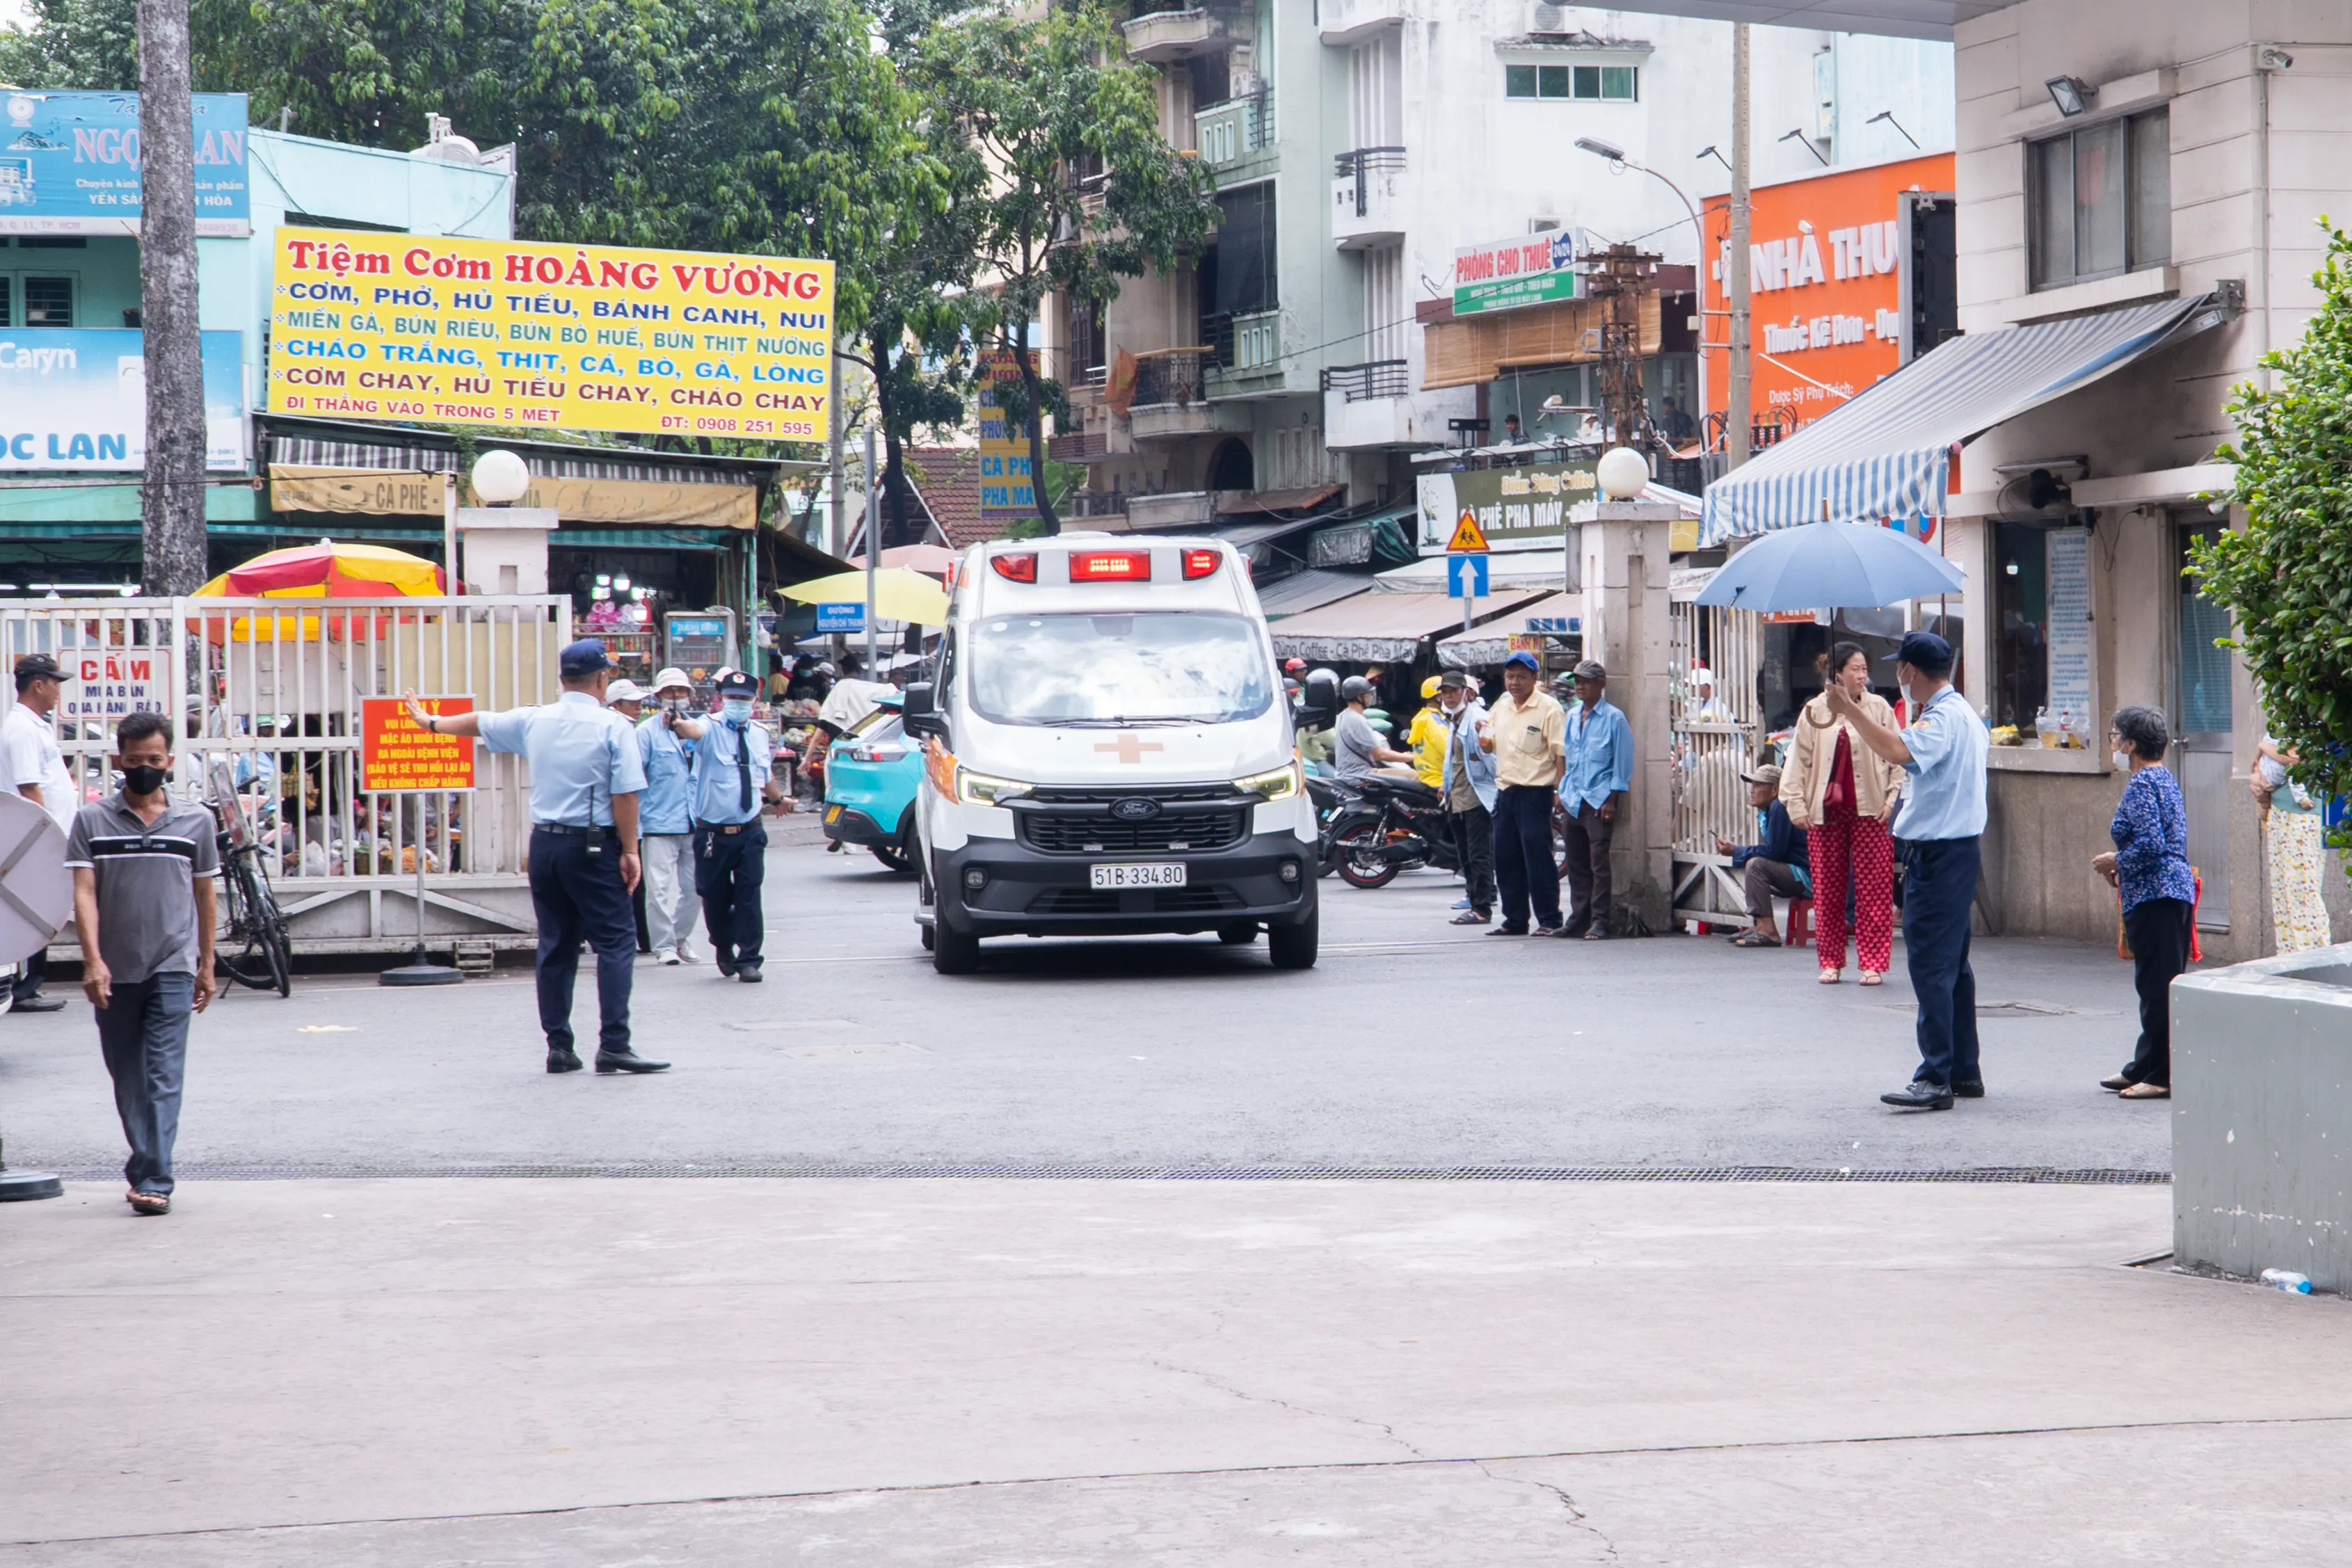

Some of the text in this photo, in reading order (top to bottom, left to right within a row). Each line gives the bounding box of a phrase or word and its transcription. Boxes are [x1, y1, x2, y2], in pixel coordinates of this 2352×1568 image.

[109, 98, 139, 118] Tạ
[74, 128, 244, 171] NGỌ AN
[288, 241, 822, 299] Tiệm Cơm HOÀNG VƯƠNG
[1457, 237, 1570, 282] PHÒNG CHO THUÊ 24/24
[1750, 221, 1898, 294] NHÀ THU
[289, 282, 825, 329] CƠM, PHỞ, HỦ TIẾU, BÁNH CANH, NUI
[351, 311, 385, 335] GÀ,
[394, 313, 437, 335] BÚN
[447, 319, 499, 342] RIÊU,
[510, 322, 551, 342] BÚN
[561, 324, 587, 343] BÒ
[598, 326, 644, 350] HUẾ,
[654, 329, 694, 349] BÚN
[704, 335, 748, 357] THỊT
[1763, 315, 1809, 354] Thuốc
[1809, 315, 1831, 349] Kê
[0, 342, 77, 374] Caryn
[287, 337, 824, 383] CHÁO TRẮNG, THỊT, CÁ, BÒ, GÀ, LÒNG
[287, 366, 826, 412] CƠM CHAY, HỦ TIẾU CHAY, CHÁO CHAY
[1769, 390, 1791, 407] Dược
[1807, 387, 1824, 403] Phụ
[287, 396, 305, 409] ĐI
[387, 397, 424, 415] VÀO
[434, 403, 495, 419] TRONG
[504, 407, 513, 419] 5
[523, 406, 560, 422] MÉT
[662, 415, 813, 435] ĐT: 0908 251 595
[48, 433, 126, 461] LAN
[983, 453, 1032, 476] CÀ PH
[376, 477, 395, 509] CÀ
[400, 478, 429, 510] PHÊ
[982, 481, 1034, 506] PHA MÁ
[1480, 502, 1503, 530] PHÊ
[1506, 504, 1530, 529] PHA
[1534, 497, 1563, 527] MÁY
[1372, 644, 1391, 659] Pha
[81, 653, 150, 680] CẤM
[397, 698, 440, 715] LU Ý
[385, 719, 399, 729] VUI
[400, 733, 412, 744] ÁO
[378, 749, 389, 759] RA
[440, 746, 459, 760] VIỆN
[459, 760, 470, 772] ÁO
[1123, 803, 1148, 813] Ford
[1095, 867, 1182, 885] 51B-334.80
